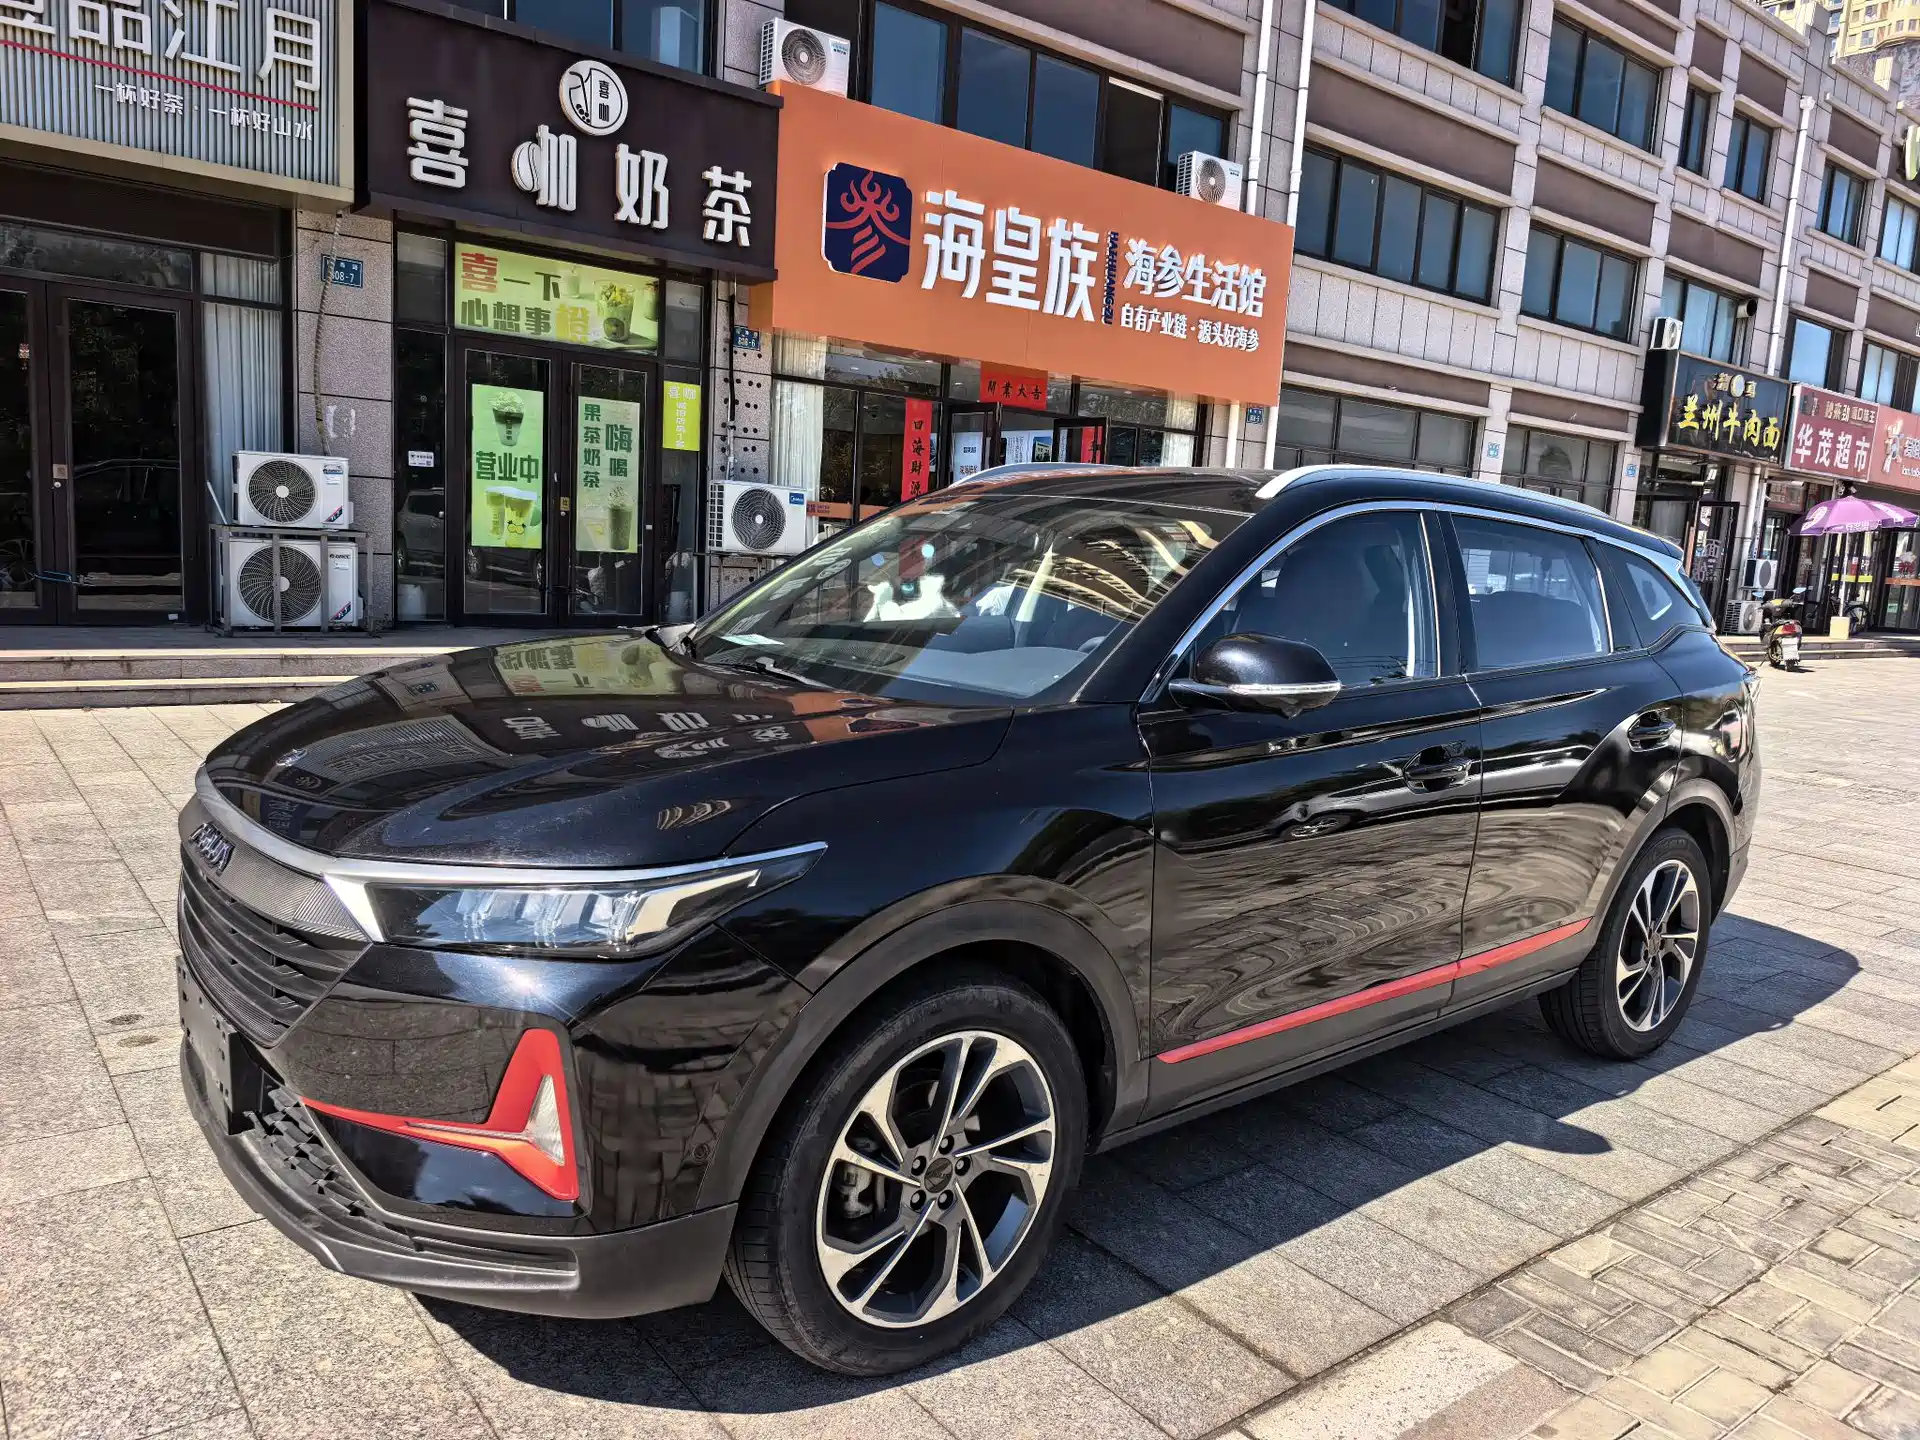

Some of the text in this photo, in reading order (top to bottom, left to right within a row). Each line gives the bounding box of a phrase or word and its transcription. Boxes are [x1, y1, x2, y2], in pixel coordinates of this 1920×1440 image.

[460, 252, 562, 301] 喜一下
[920, 190, 1100, 322] 海皇族
[1122, 238, 1267, 318] 海参生活馆
[460, 297, 591, 345] 心想事橙
[583, 403, 601, 489] 果茶奶茶
[1678, 393, 1781, 451] 兰州牛肉面
[1794, 423, 1871, 473] 华茂超市
[475, 450, 539, 483] 营业中
[605, 424, 633, 478] 嗨喝
